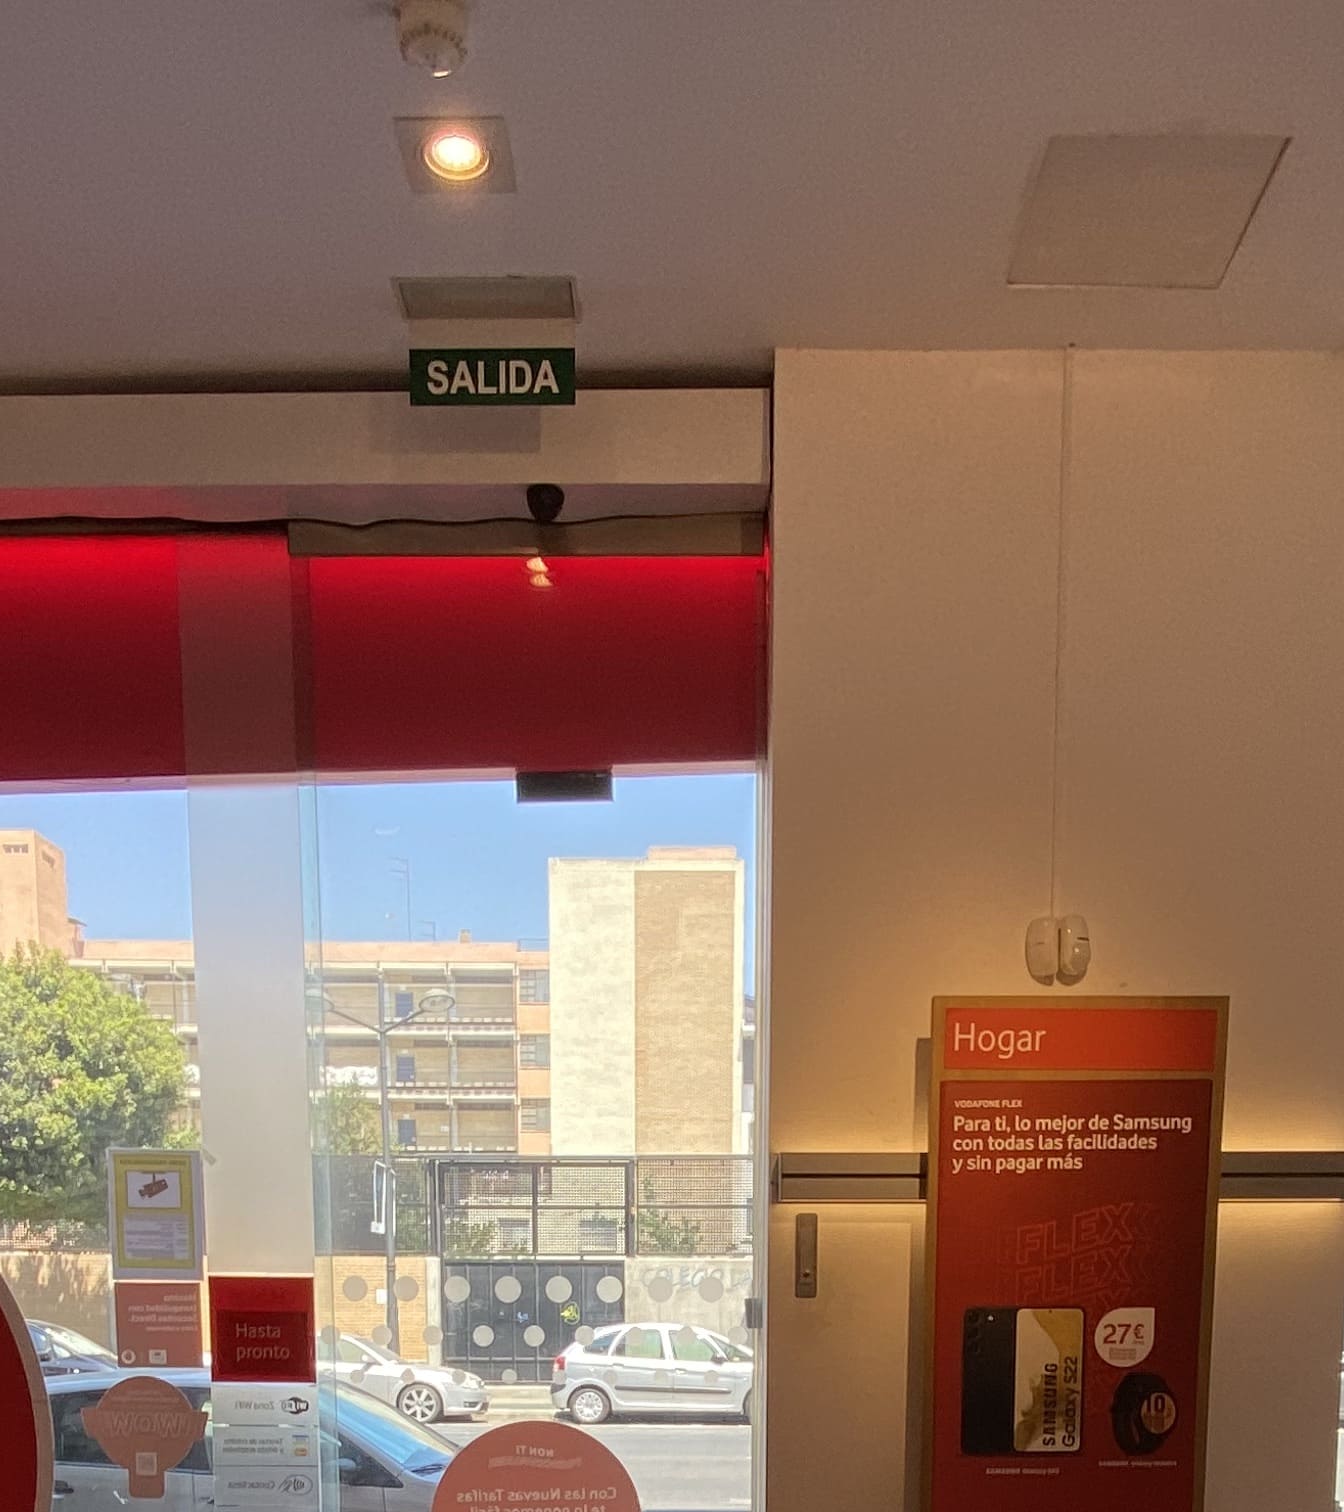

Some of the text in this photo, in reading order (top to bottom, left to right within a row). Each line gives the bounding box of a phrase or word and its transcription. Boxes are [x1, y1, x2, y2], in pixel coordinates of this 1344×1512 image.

[427, 360, 559, 394] SALIDA
[953, 1022, 1046, 1059] Hogar
[953, 1114, 1192, 1135] Para ti, lo mejor de Samsung
[953, 1134, 1158, 1151] con todas las facilidades
[952, 1153, 1083, 1174] y sin pagar más
[236, 1323, 281, 1338] Hasta
[1103, 1323, 1144, 1345] 27€
[236, 1344, 291, 1362] pronto
[1042, 1362, 1059, 1446] SAMSUNG
[1062, 1356, 1081, 1447] Galaxy S22
